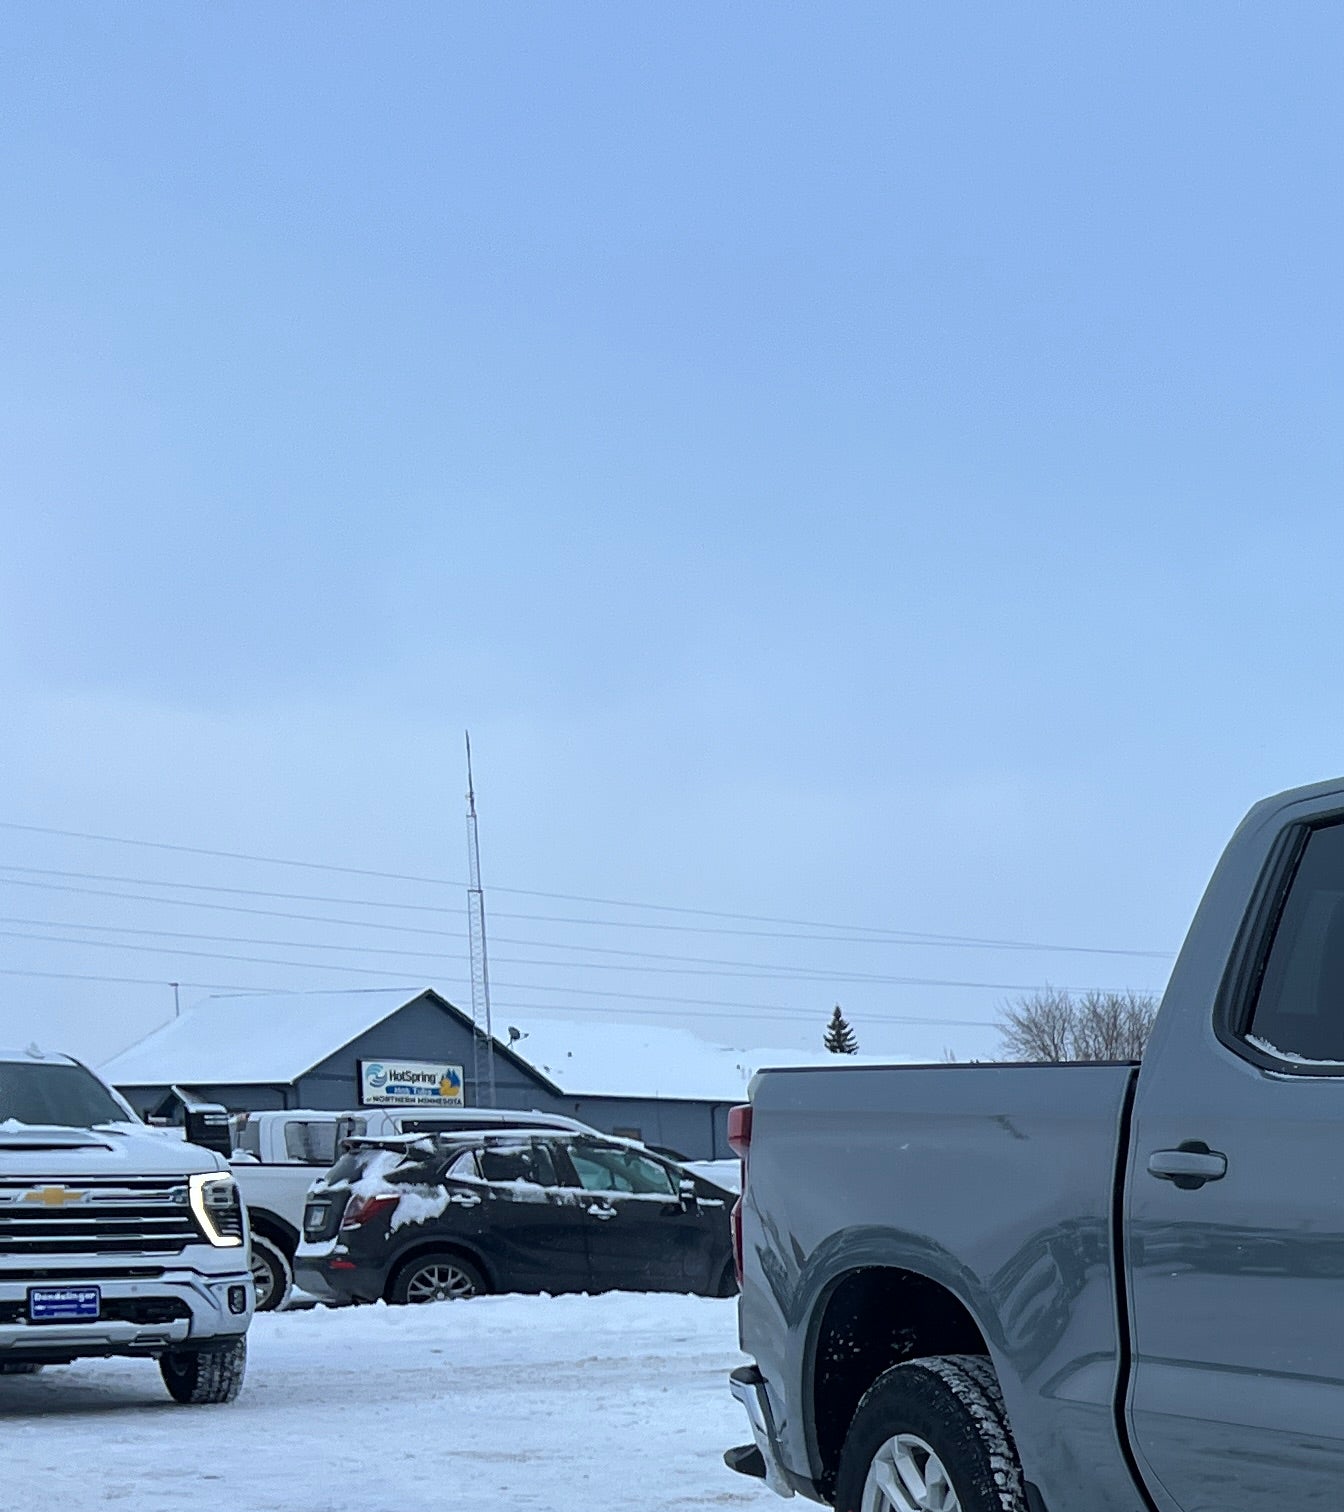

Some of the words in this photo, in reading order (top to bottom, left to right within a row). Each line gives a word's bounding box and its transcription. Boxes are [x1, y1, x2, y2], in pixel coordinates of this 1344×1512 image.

[389, 1069, 436, 1085] HotSpring
[373, 1095, 416, 1103] NORTHERN
[418, 1096, 462, 1105] MINNESOTA
